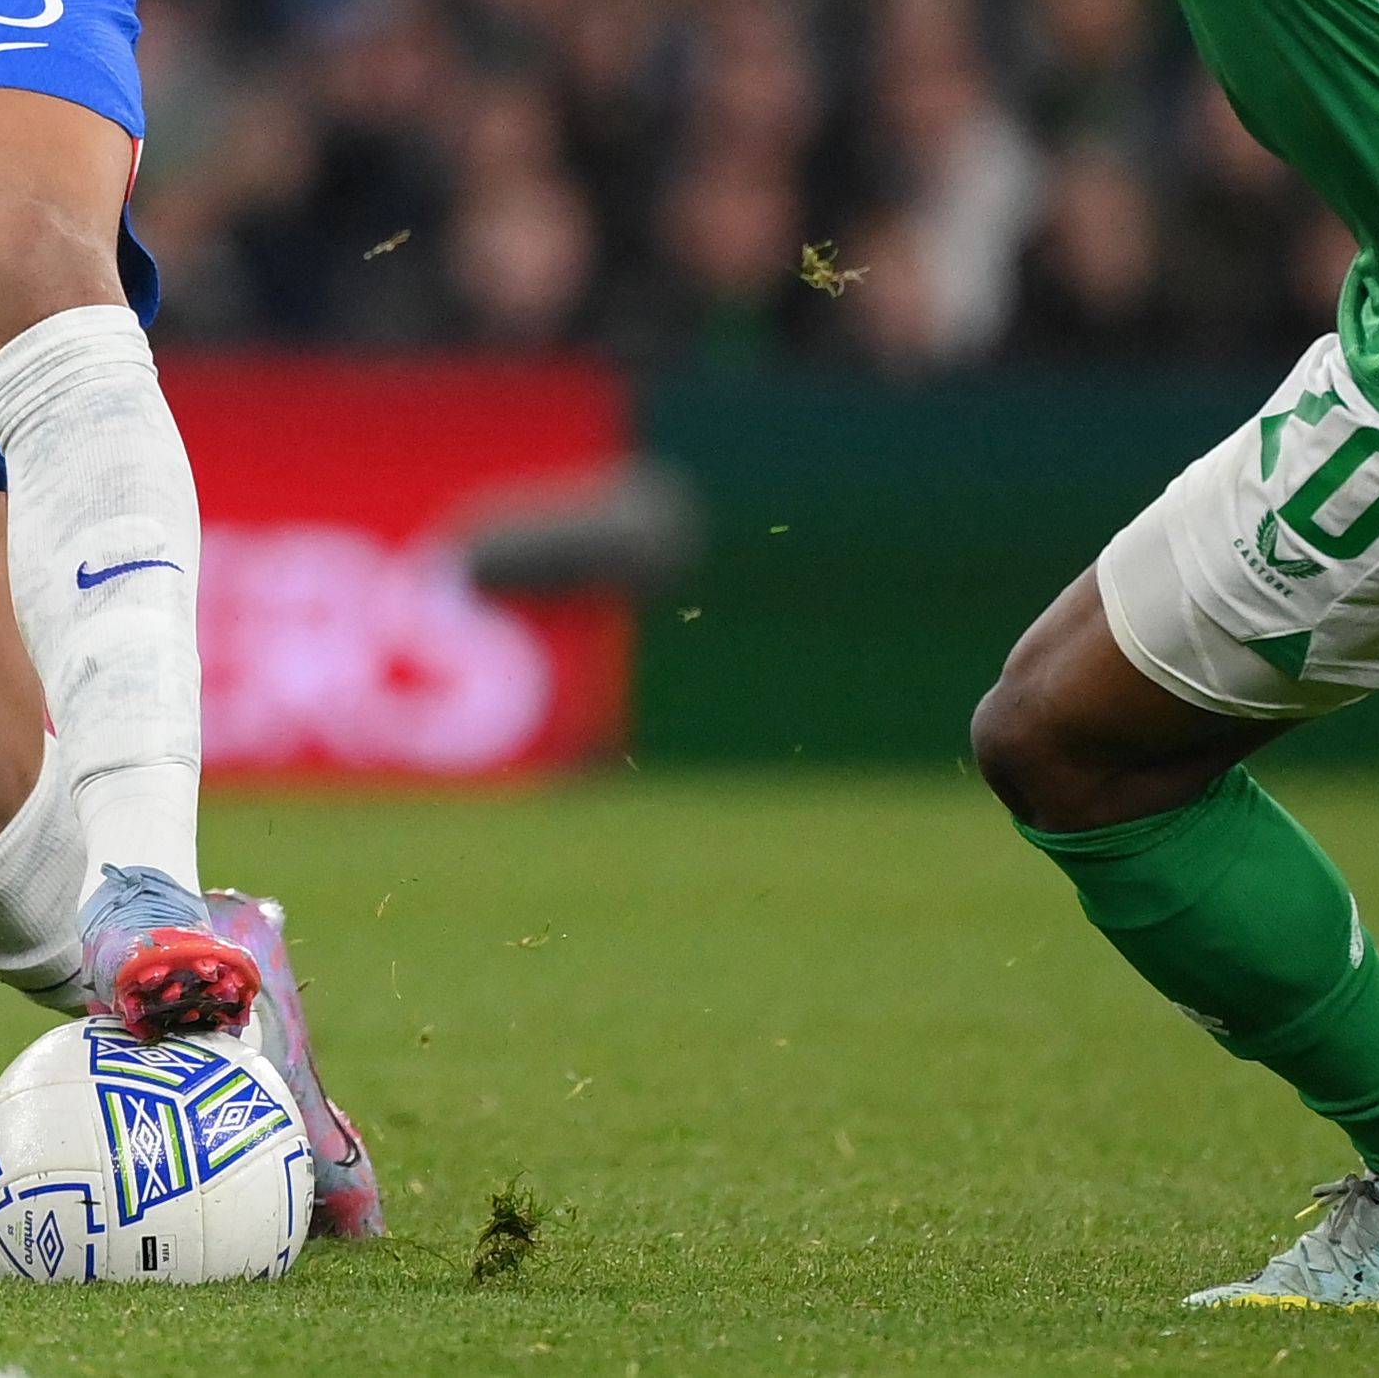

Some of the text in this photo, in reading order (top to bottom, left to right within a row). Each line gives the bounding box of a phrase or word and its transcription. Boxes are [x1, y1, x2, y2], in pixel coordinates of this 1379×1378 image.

[1233, 537, 1294, 598] CASTORE
[24, 1210, 35, 1265] umbro
[161, 1242, 170, 1263] FIFA
